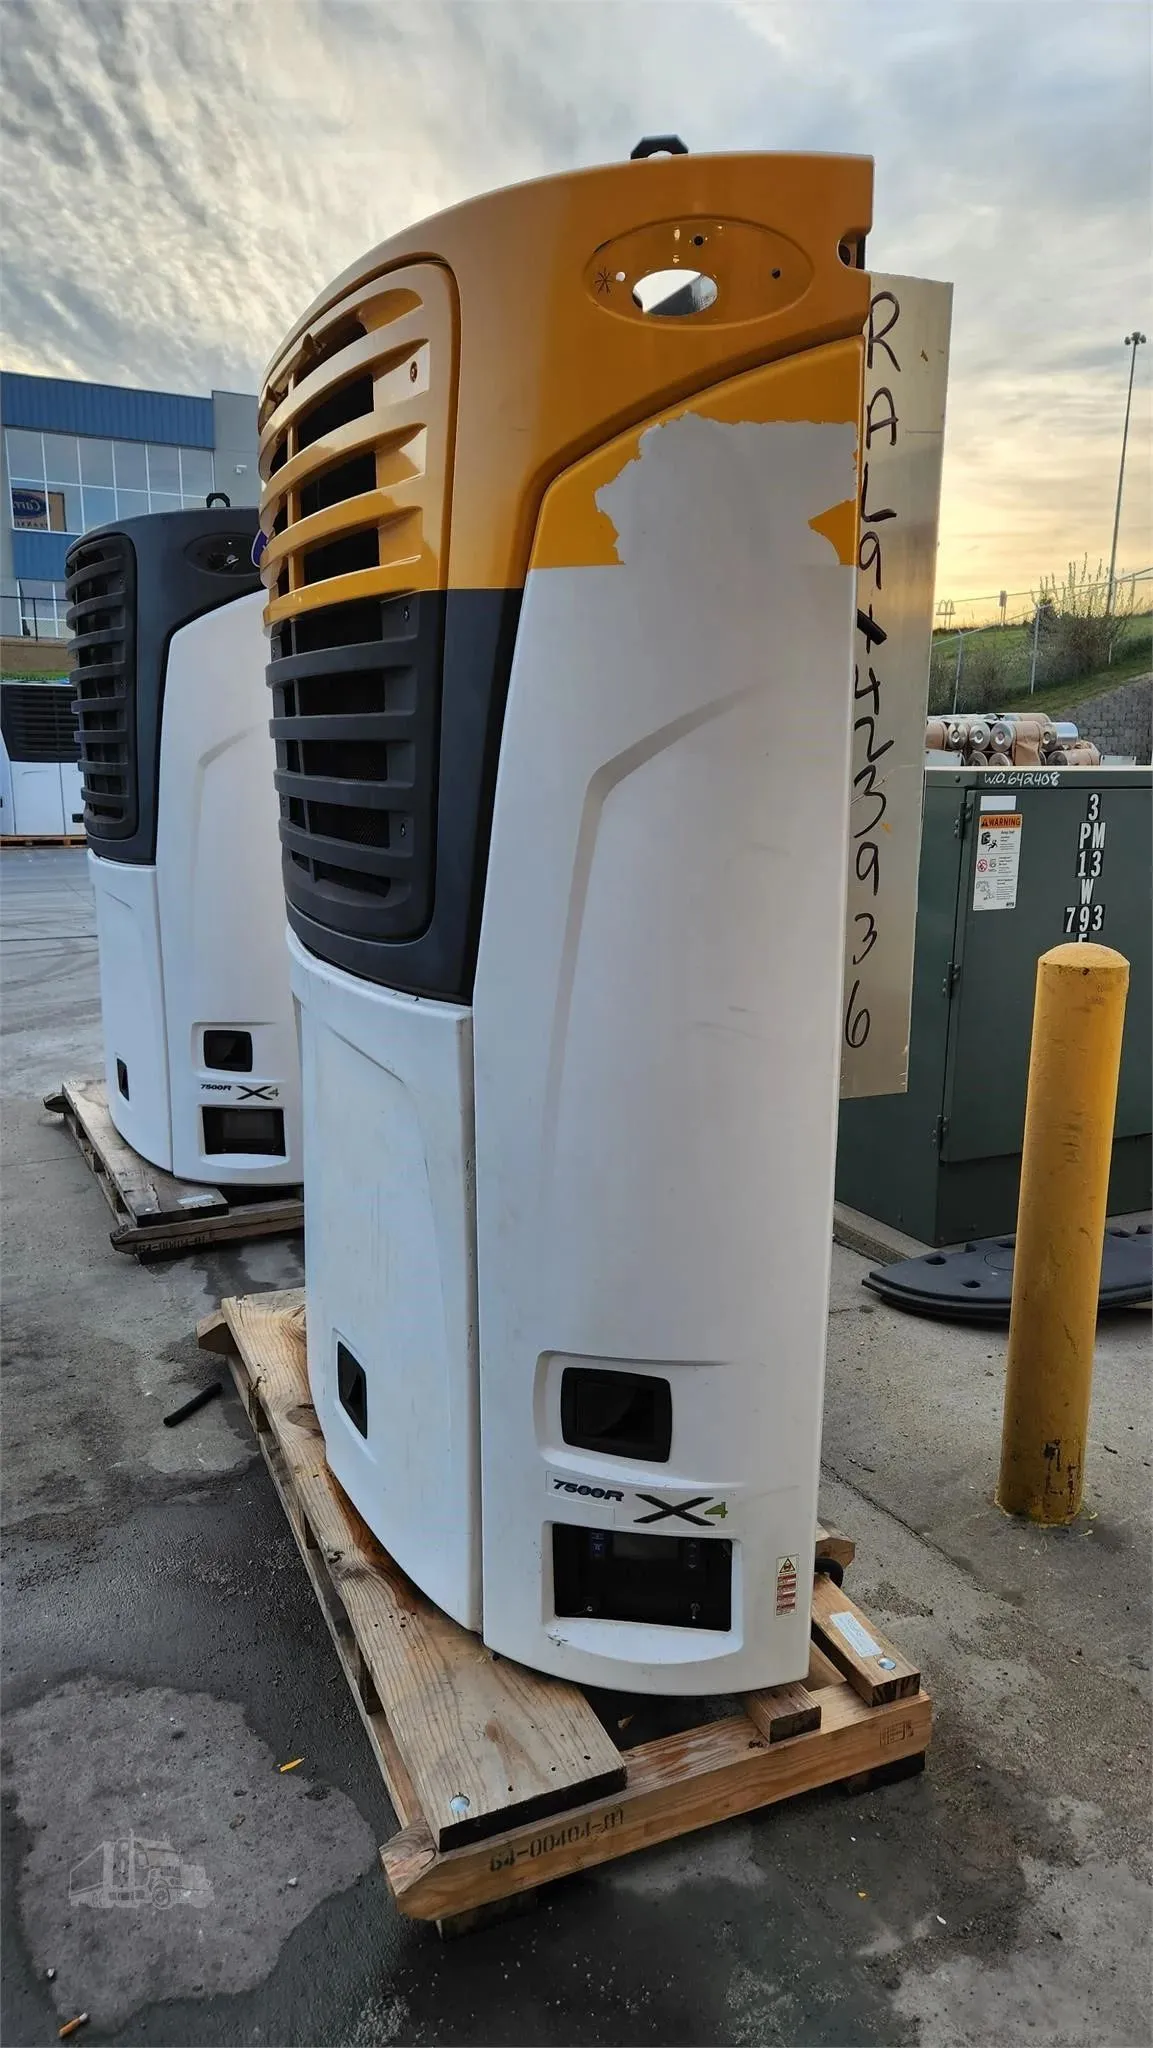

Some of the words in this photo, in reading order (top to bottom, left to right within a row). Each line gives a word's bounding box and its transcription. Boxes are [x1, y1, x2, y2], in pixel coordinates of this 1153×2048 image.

[1088, 793, 1099, 820] 3
[988, 816, 1021, 827] WARNING
[1079, 822, 1106, 849] PM
[1077, 850, 1101, 877] 13
[1080, 878, 1094, 904] W
[1065, 906, 1103, 932] 793
[200, 1083, 232, 1092] 7500R
[553, 1479, 625, 1501] 7500R
